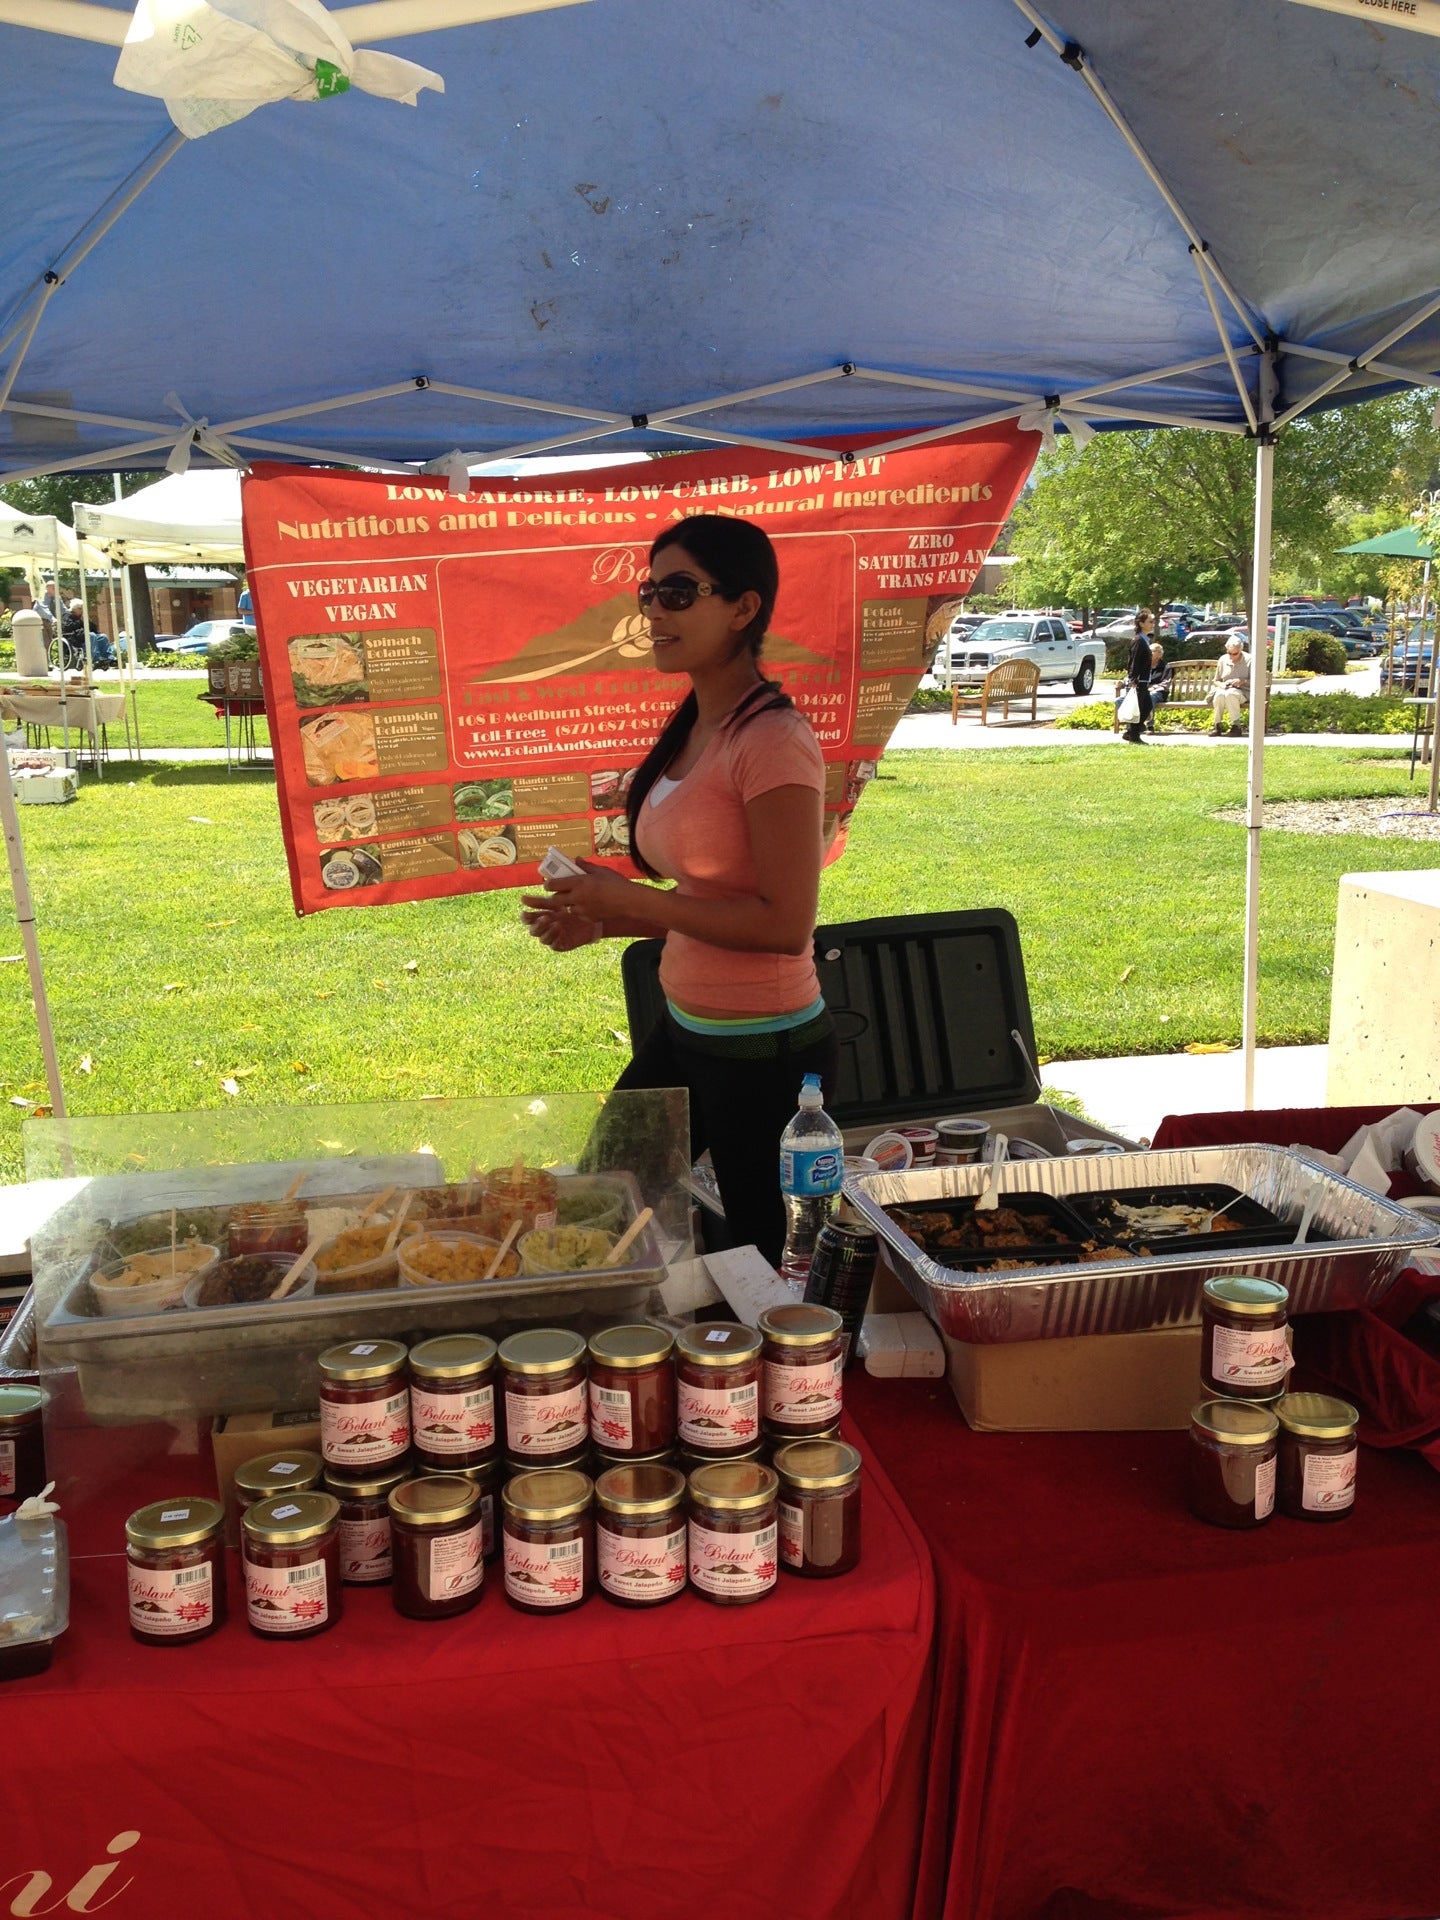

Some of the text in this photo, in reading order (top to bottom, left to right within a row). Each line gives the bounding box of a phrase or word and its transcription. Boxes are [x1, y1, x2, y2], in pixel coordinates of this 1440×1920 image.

[1391, 1, 1416, 15] HERE
[386, 454, 886, 507] LOW-CALORIE, LOW-CARB, LOW-FAT
[278, 512, 430, 542] Nutritious
[438, 510, 498, 532] and
[507, 509, 636, 528] Delicious
[832, 481, 993, 509] Ingredients
[908, 533, 955, 550] ZERO
[858, 551, 960, 573] SATURATED
[286, 573, 428, 599] VEGETARIAN
[877, 567, 978, 590] TRANS FATS
[325, 602, 398, 624] VEGAN
[863, 606, 904, 617] Potato
[863, 616, 903, 628] Bolani
[365, 636, 422, 649] Spinach
[367, 646, 410, 660] Bolani
[859, 682, 891, 695] Lentil
[858, 692, 893, 705] Bolani
[457, 713, 486, 727] 108
[504, 707, 581, 723] Medburn
[584, 702, 636, 717] Street,
[640, 700, 681, 712] Conc
[799, 692, 846, 706] 94520
[374, 711, 438, 725] Pumpkin
[375, 723, 418, 736] Bolani
[471, 729, 547, 744] Toll-Free:
[555, 722, 595, 738] (877)
[598, 716, 668, 733] 687-0817
[513, 774, 577, 786] Cilantro Pesto
[404, 786, 425, 796] Mint
[375, 797, 407, 808] Cheese
[516, 823, 559, 832] Hummus
[381, 837, 422, 850] Eggplant
[1245, 1341, 1285, 1357] Bolan
[789, 1376, 834, 1395] Bolani
[419, 1404, 467, 1422] Bolani
[537, 1401, 582, 1422] Bolani
[685, 1397, 732, 1417] Bolani
[336, 1415, 389, 1431] Bolani
[536, 1436, 557, 1444] Sweet
[616, 1550, 669, 1566] Bolani
[703, 1542, 755, 1561] Bolani
[506, 1548, 551, 1572] Bolani
[128, 1578, 176, 1600] Bolani
[247, 1575, 290, 1597] Bolani
